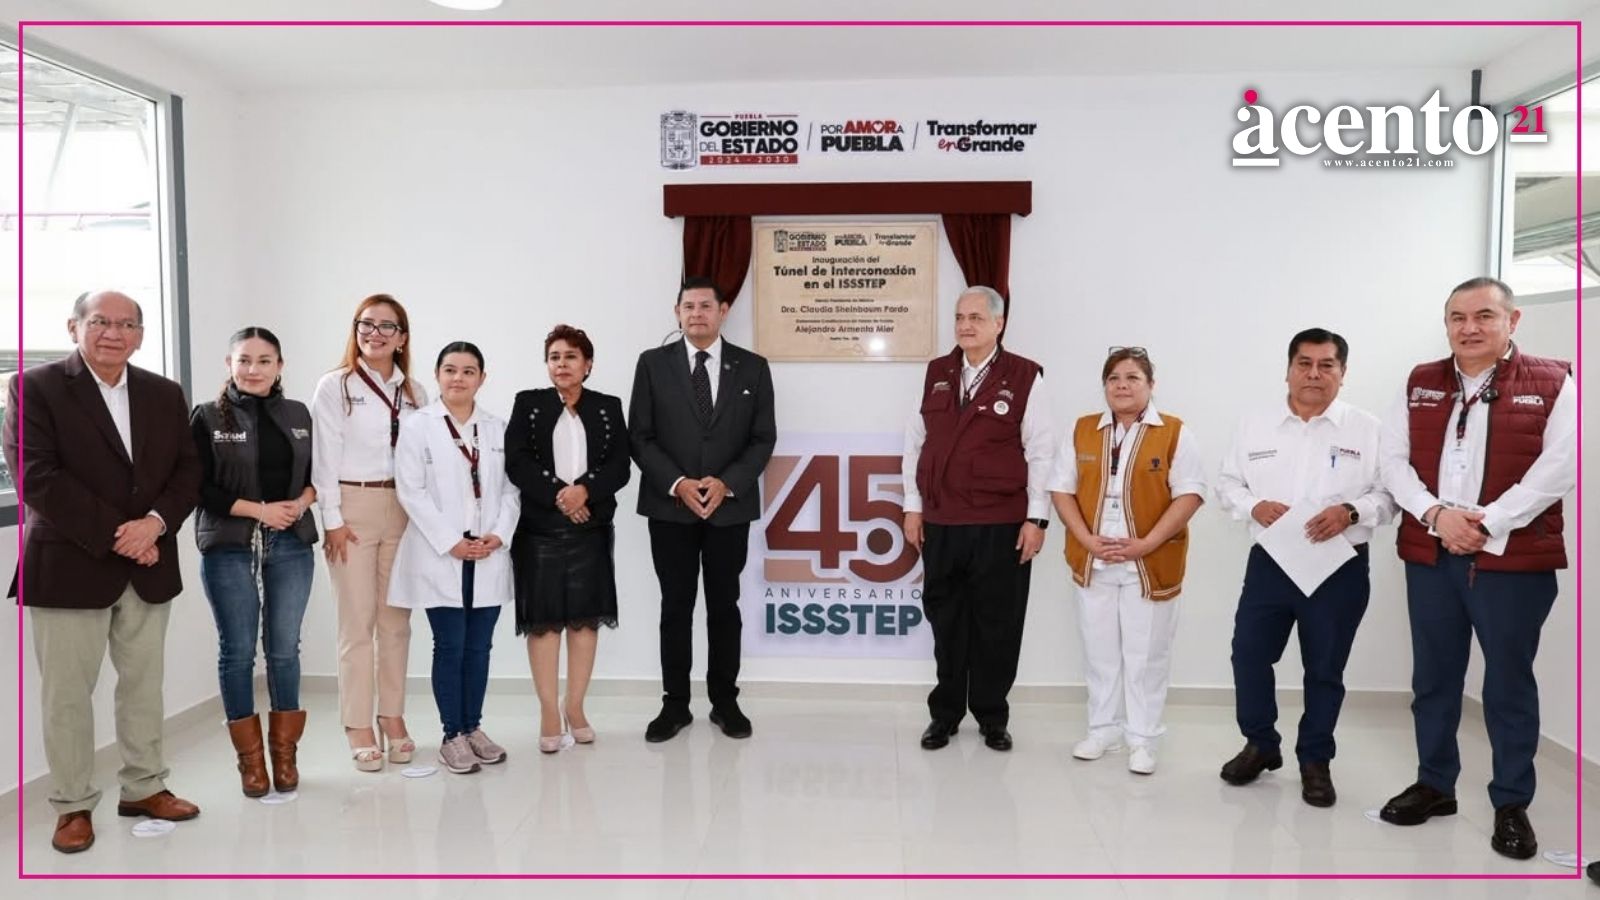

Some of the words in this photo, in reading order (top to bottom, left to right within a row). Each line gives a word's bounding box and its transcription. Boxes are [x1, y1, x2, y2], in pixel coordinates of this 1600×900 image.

[700, 120, 798, 137] GOBIERNO
[821, 125, 843, 134] POR
[843, 120, 896, 134] AMOR
[927, 120, 1037, 136] Transformar
[700, 141, 719, 153] DEL
[722, 138, 798, 154] ESTADO
[821, 135, 904, 152] PUEBLA
[757, 155, 790, 163] 2030
[812, 255, 865, 264] Inauguración
[866, 255, 880, 263] del
[774, 265, 808, 276] Túnel
[811, 266, 827, 276] de
[831, 265, 916, 276] Interconexión
[803, 280, 820, 289] en
[823, 278, 834, 289] el
[839, 278, 886, 289] ISSSTEP
[781, 305, 798, 314] Dra.
[800, 305, 833, 314] Claudia
[835, 305, 882, 314] Sheinbaum
[884, 305, 909, 314] Pardo
[795, 325, 835, 335] Alejandro
[838, 325, 874, 333] Armenta
[876, 325, 894, 333] Mier
[764, 454, 920, 584] 45
[764, 587, 922, 600] ANIVERSARIO
[765, 603, 923, 636] ISSSTEP
